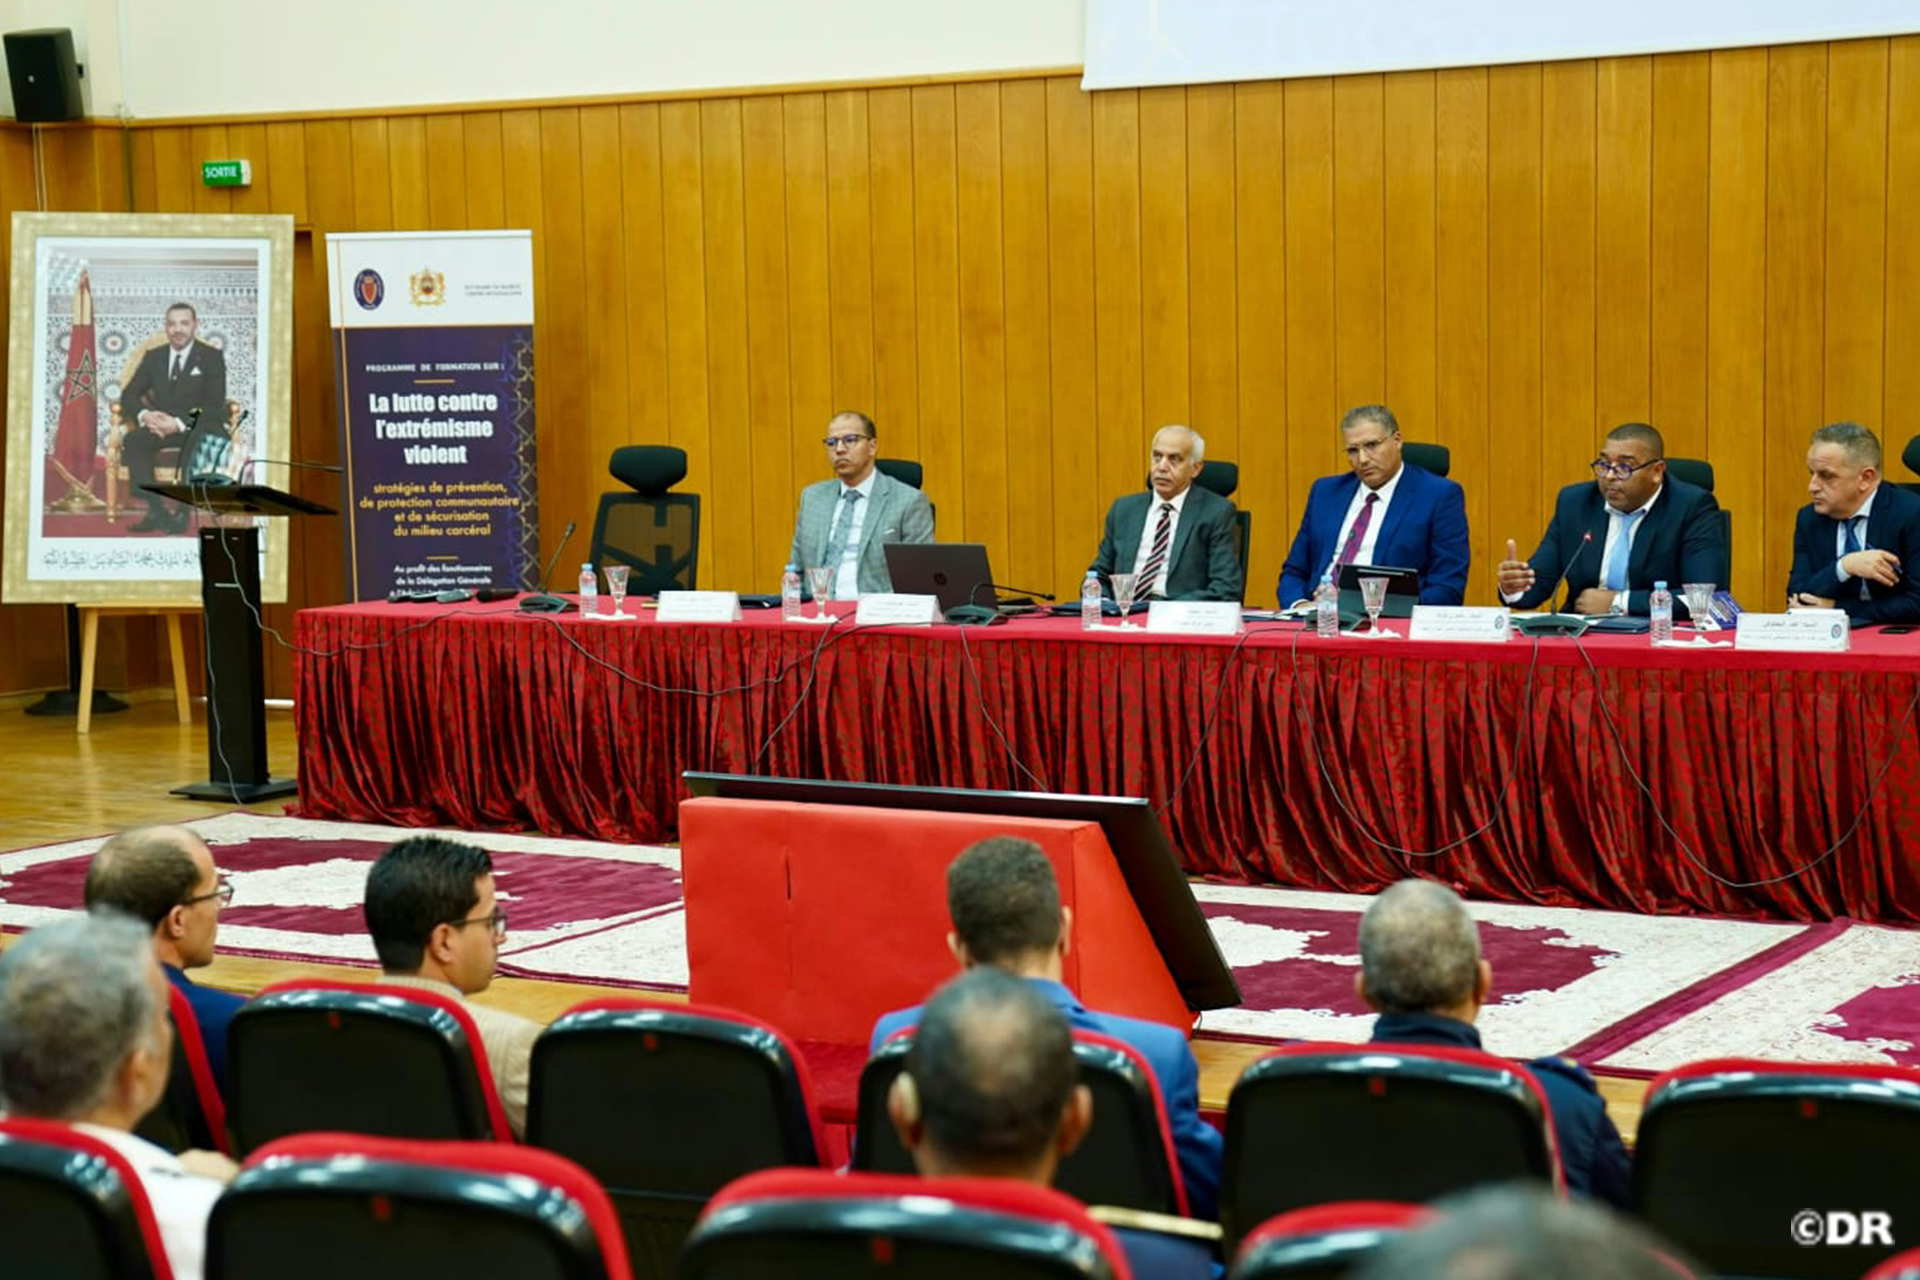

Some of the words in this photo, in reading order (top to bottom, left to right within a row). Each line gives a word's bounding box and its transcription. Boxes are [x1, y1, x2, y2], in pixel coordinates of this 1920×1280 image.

[205, 166, 237, 178] SORTIE
[366, 364, 416, 372] PROGRAMME
[420, 363, 431, 372] DE
[435, 363, 481, 372] FORMATION
[483, 362, 499, 371] SUR
[369, 393, 390, 413] La
[392, 392, 435, 413] lutte
[438, 392, 498, 412] contre
[375, 418, 493, 439] l'extrémisme
[404, 444, 468, 465] violent
[373, 482, 426, 496] stratégies
[428, 481, 443, 493] de
[446, 481, 507, 495] prévention,
[359, 496, 374, 509] de
[377, 497, 432, 511] protection
[435, 496, 520, 508] communautaire
[394, 512, 405, 522] et
[408, 510, 422, 522] de
[425, 510, 489, 522] sécurisation
[393, 524, 408, 536] du
[411, 524, 443, 536] milieu
[446, 523, 491, 536] carcéral
